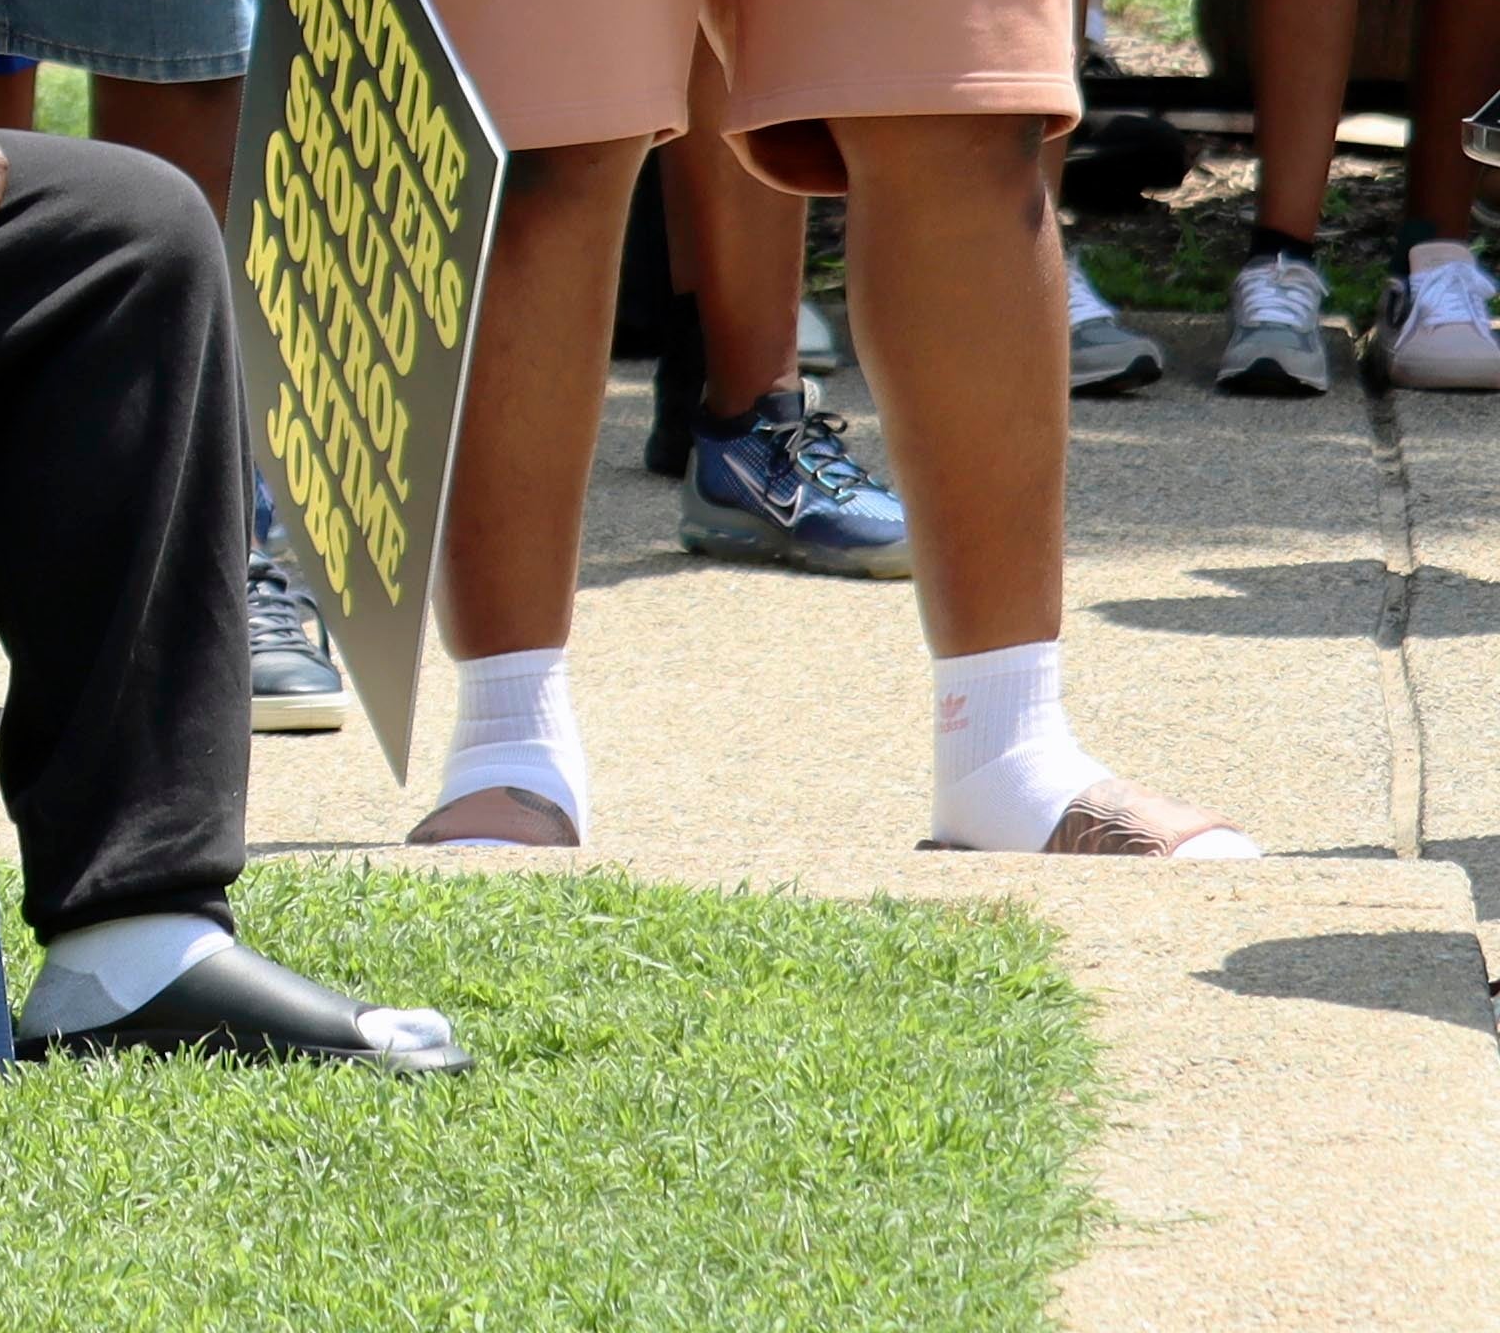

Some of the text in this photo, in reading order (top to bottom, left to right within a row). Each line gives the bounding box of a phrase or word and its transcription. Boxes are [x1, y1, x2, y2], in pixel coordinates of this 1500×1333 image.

[265, 134, 409, 505] CONTROL
[286, 54, 414, 379] SHOULD
[243, 197, 407, 609] MARITIME
[265, 380, 353, 619] JOBS.
